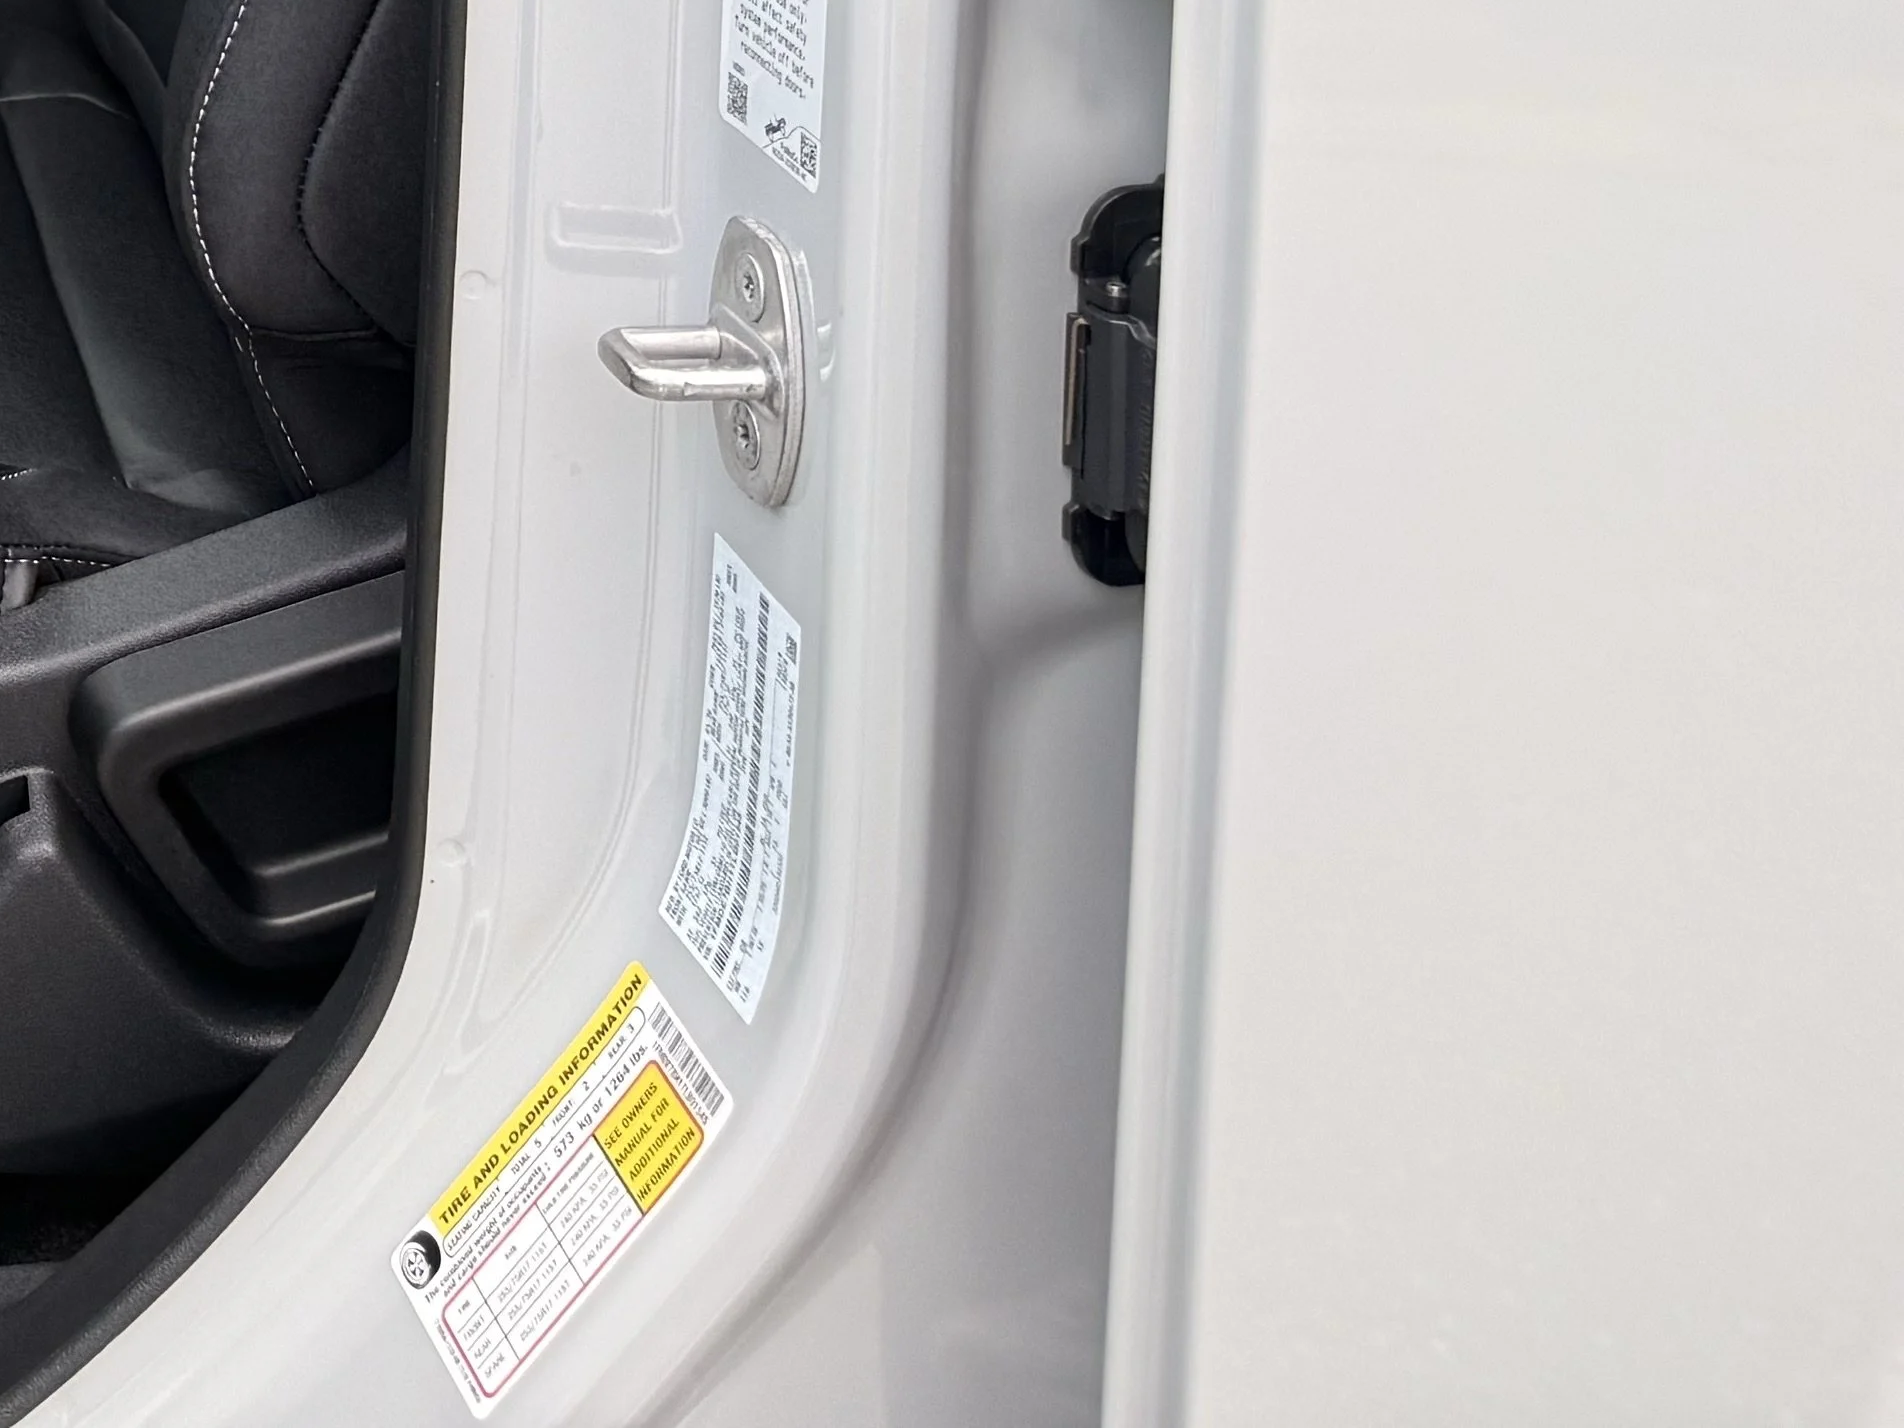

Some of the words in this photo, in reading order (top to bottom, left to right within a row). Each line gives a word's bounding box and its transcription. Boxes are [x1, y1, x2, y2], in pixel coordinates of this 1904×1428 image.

[438, 1185, 471, 1224] TIRE
[472, 1153, 500, 1189] AND
[499, 1084, 558, 1154] LOADING
[558, 973, 642, 1085] INFORMATION
[552, 1130, 575, 1158] 573
[576, 1112, 593, 1130] kg
[591, 1097, 603, 1114] or
[604, 1063, 630, 1096] 1264
[628, 1044, 648, 1066] lbs.
[581, 1079, 590, 1092] 2
[603, 1125, 623, 1149] SEE
[621, 1081, 658, 1129] OWNERS
[614, 1122, 652, 1167] MANUAL
[649, 1096, 670, 1122] FOR
[628, 1118, 679, 1181] ADDITIONAL
[636, 1126, 695, 1201] INFORMATION
[423, 1285, 440, 1303] The
